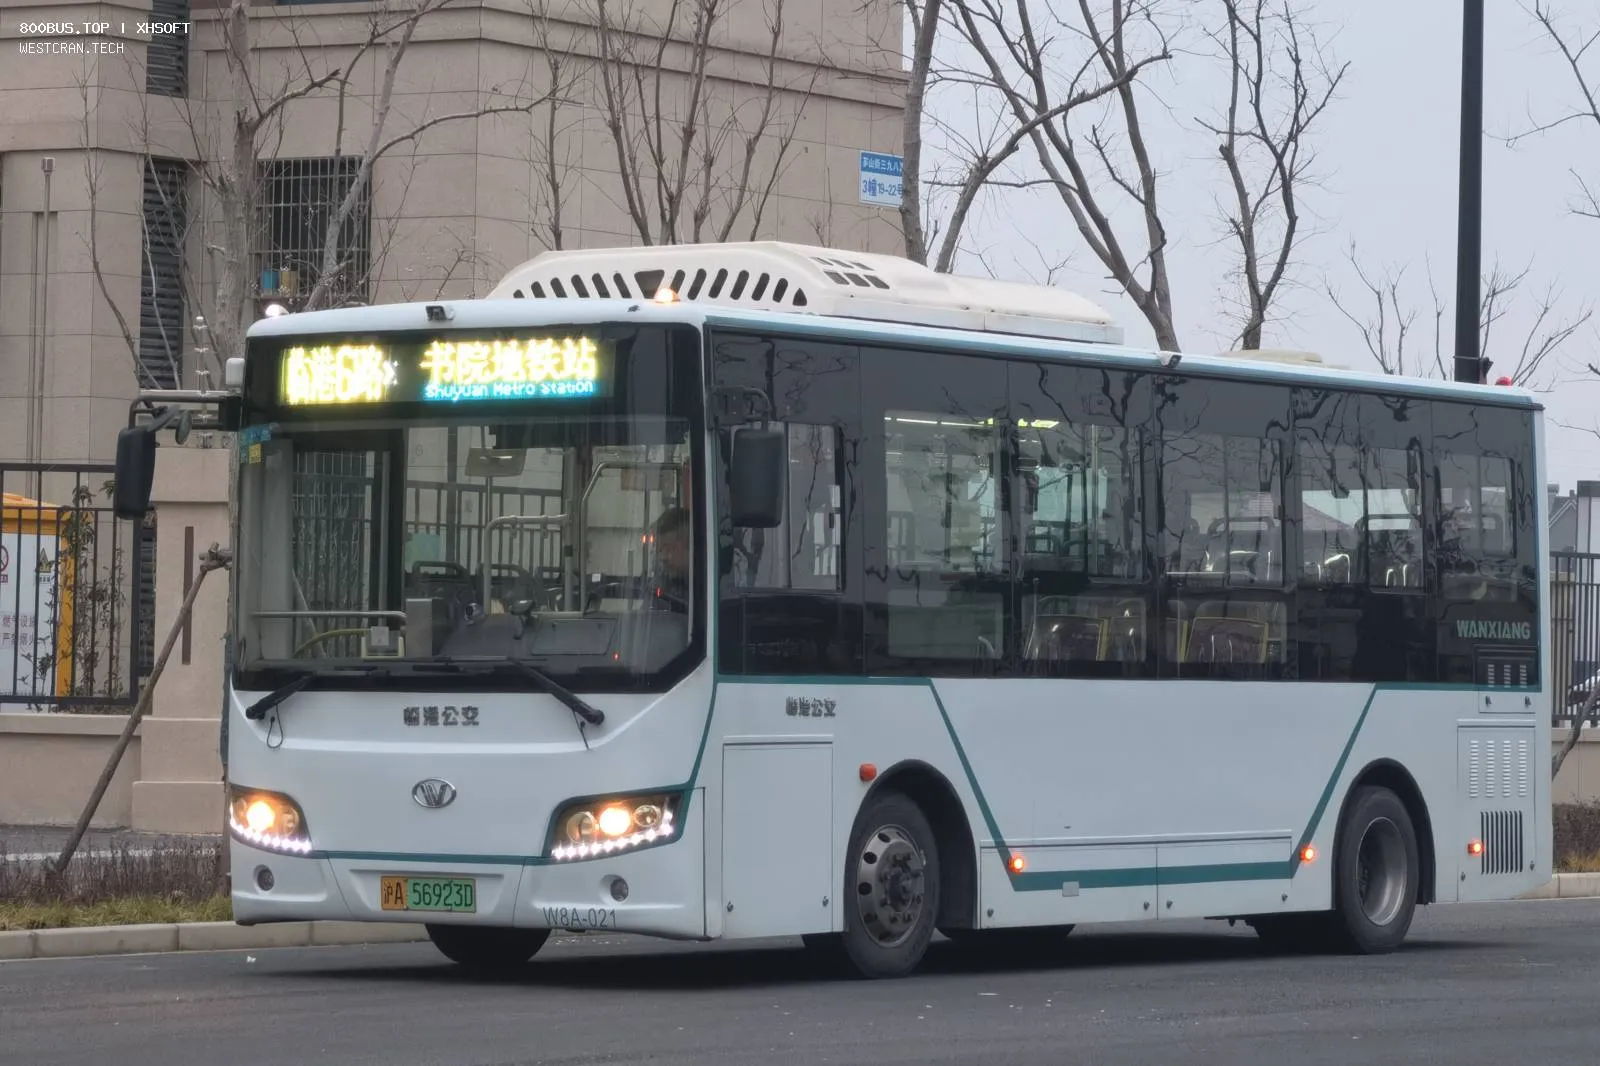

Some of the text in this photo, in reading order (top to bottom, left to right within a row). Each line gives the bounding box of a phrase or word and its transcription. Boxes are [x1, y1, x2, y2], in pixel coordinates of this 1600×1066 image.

[420, 336, 597, 385] 书院地铁站
[492, 381, 536, 397] Metro
[1456, 619, 1531, 640] WANXIANG
[542, 906, 617, 929] W8A-021
